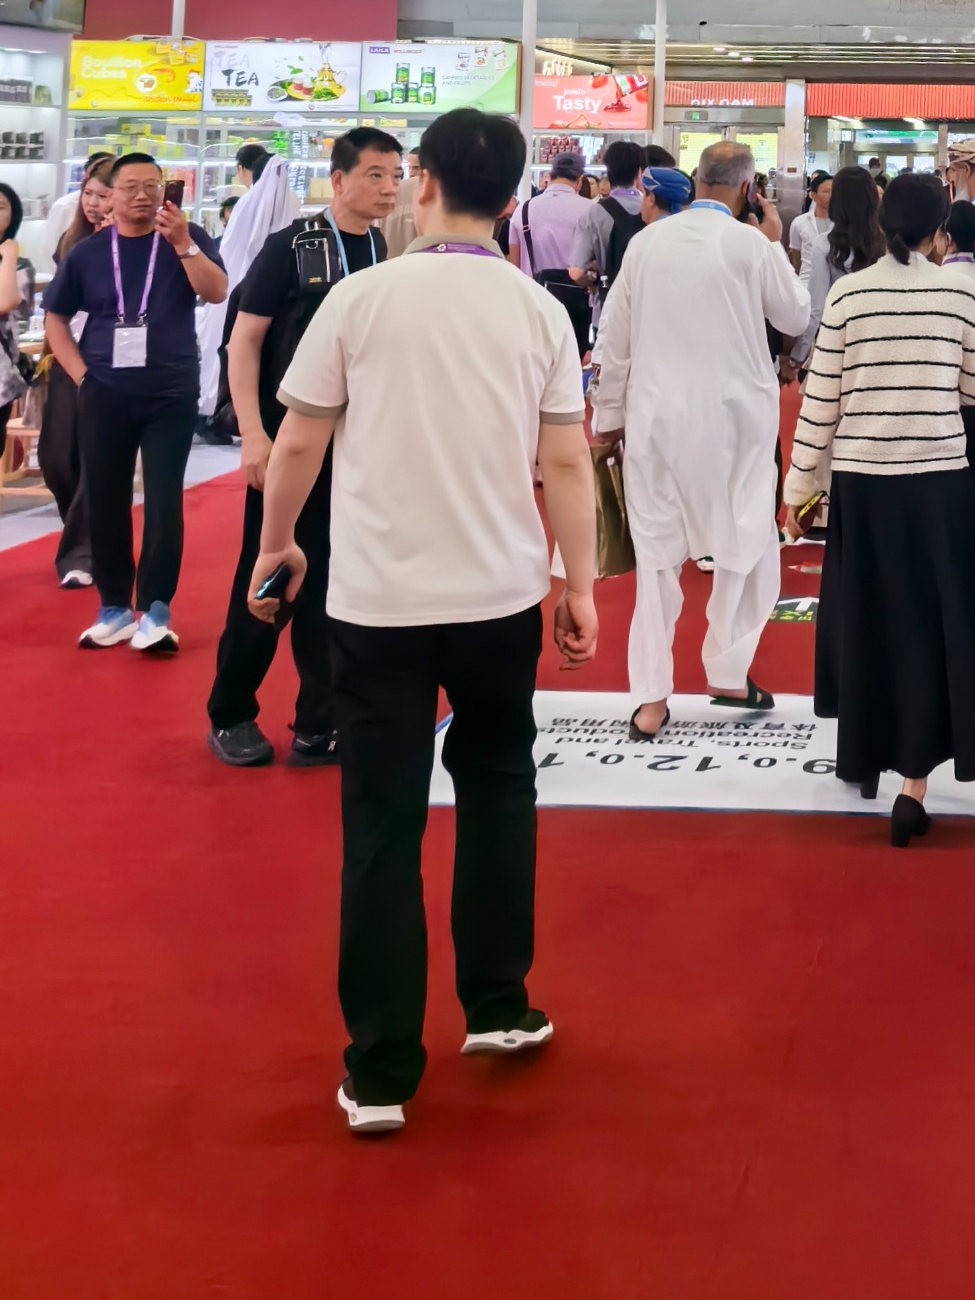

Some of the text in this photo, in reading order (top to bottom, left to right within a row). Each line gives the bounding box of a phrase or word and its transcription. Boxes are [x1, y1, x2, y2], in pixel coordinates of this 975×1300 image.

[82, 67, 127, 78] Cubes
[222, 69, 259, 87] TEA
[553, 96, 601, 113] Tasty
[664, 729, 812, 740] Recreation
[555, 736, 602, 745] and
[710, 739, 808, 750] Sports,
[586, 750, 721, 772] 12.0,
